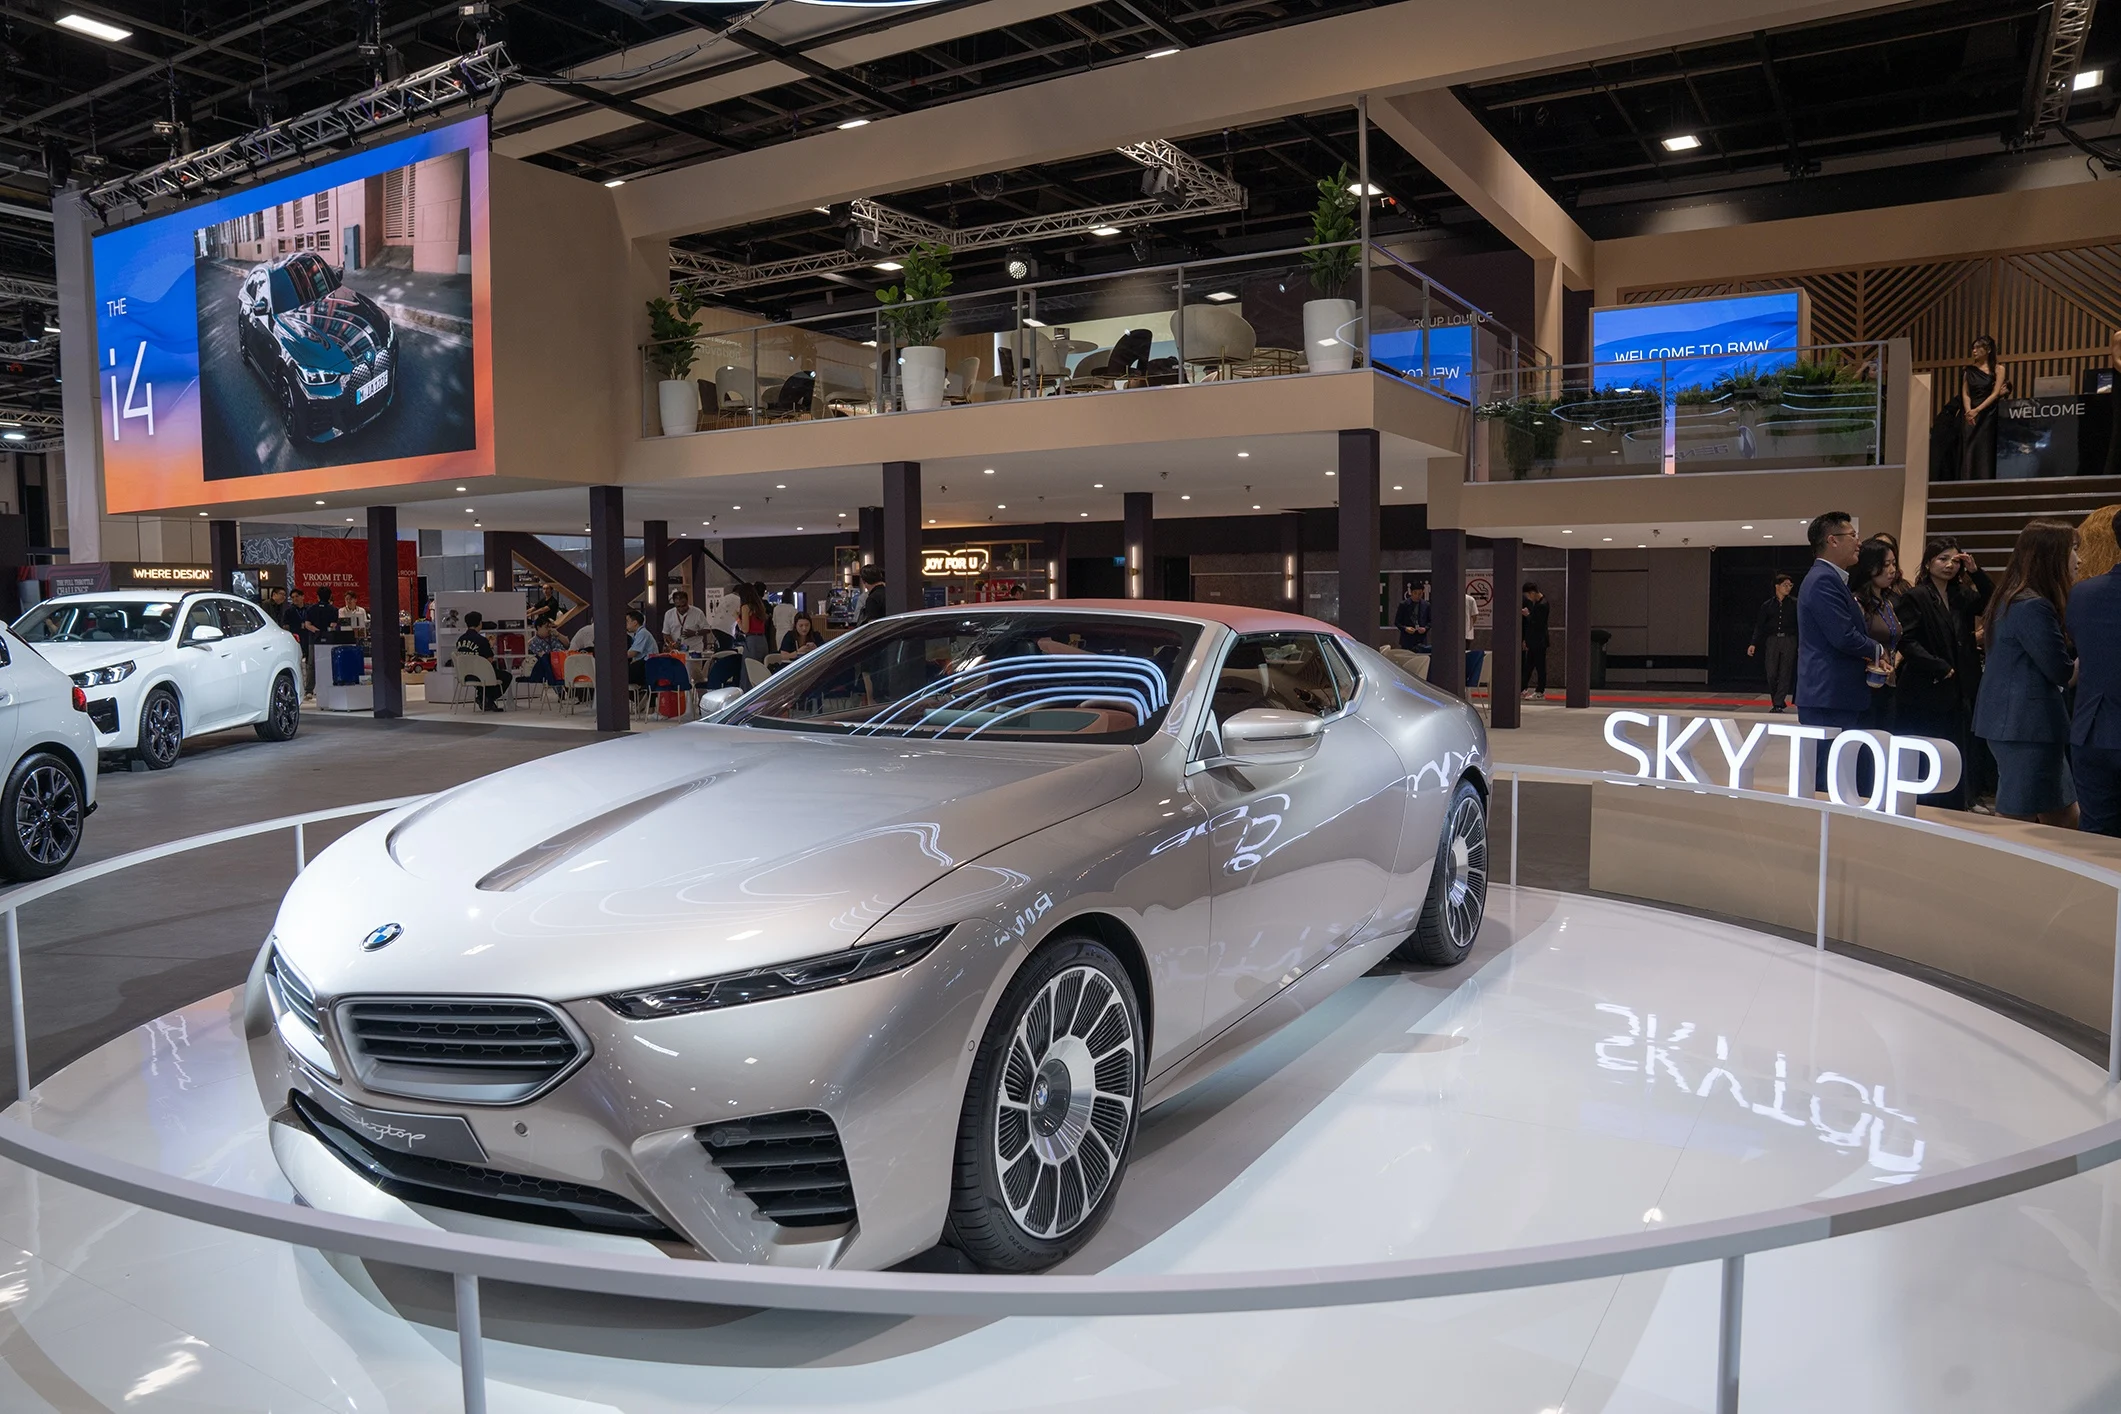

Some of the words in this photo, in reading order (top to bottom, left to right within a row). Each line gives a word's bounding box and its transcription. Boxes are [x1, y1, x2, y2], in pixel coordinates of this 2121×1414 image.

[107, 298, 127, 317] THE
[1410, 316, 1445, 328] RUP
[1615, 345, 1695, 362] WELCOME
[1700, 343, 1722, 355] TO
[1727, 340, 1769, 354] BMW
[109, 340, 154, 441] i4
[2009, 403, 2085, 419] WELCOME
[924, 557, 944, 571] JOY
[945, 557, 967, 570] FOR
[968, 557, 978, 569] U
[134, 568, 171, 579] WHERE
[173, 569, 209, 580] DESIGN
[302, 573, 331, 581] VROOM
[333, 573, 341, 581] IT
[342, 573, 354, 581] UP.
[1603, 710, 1950, 816] SKYTOP
[340, 1105, 426, 1148] Skytop
